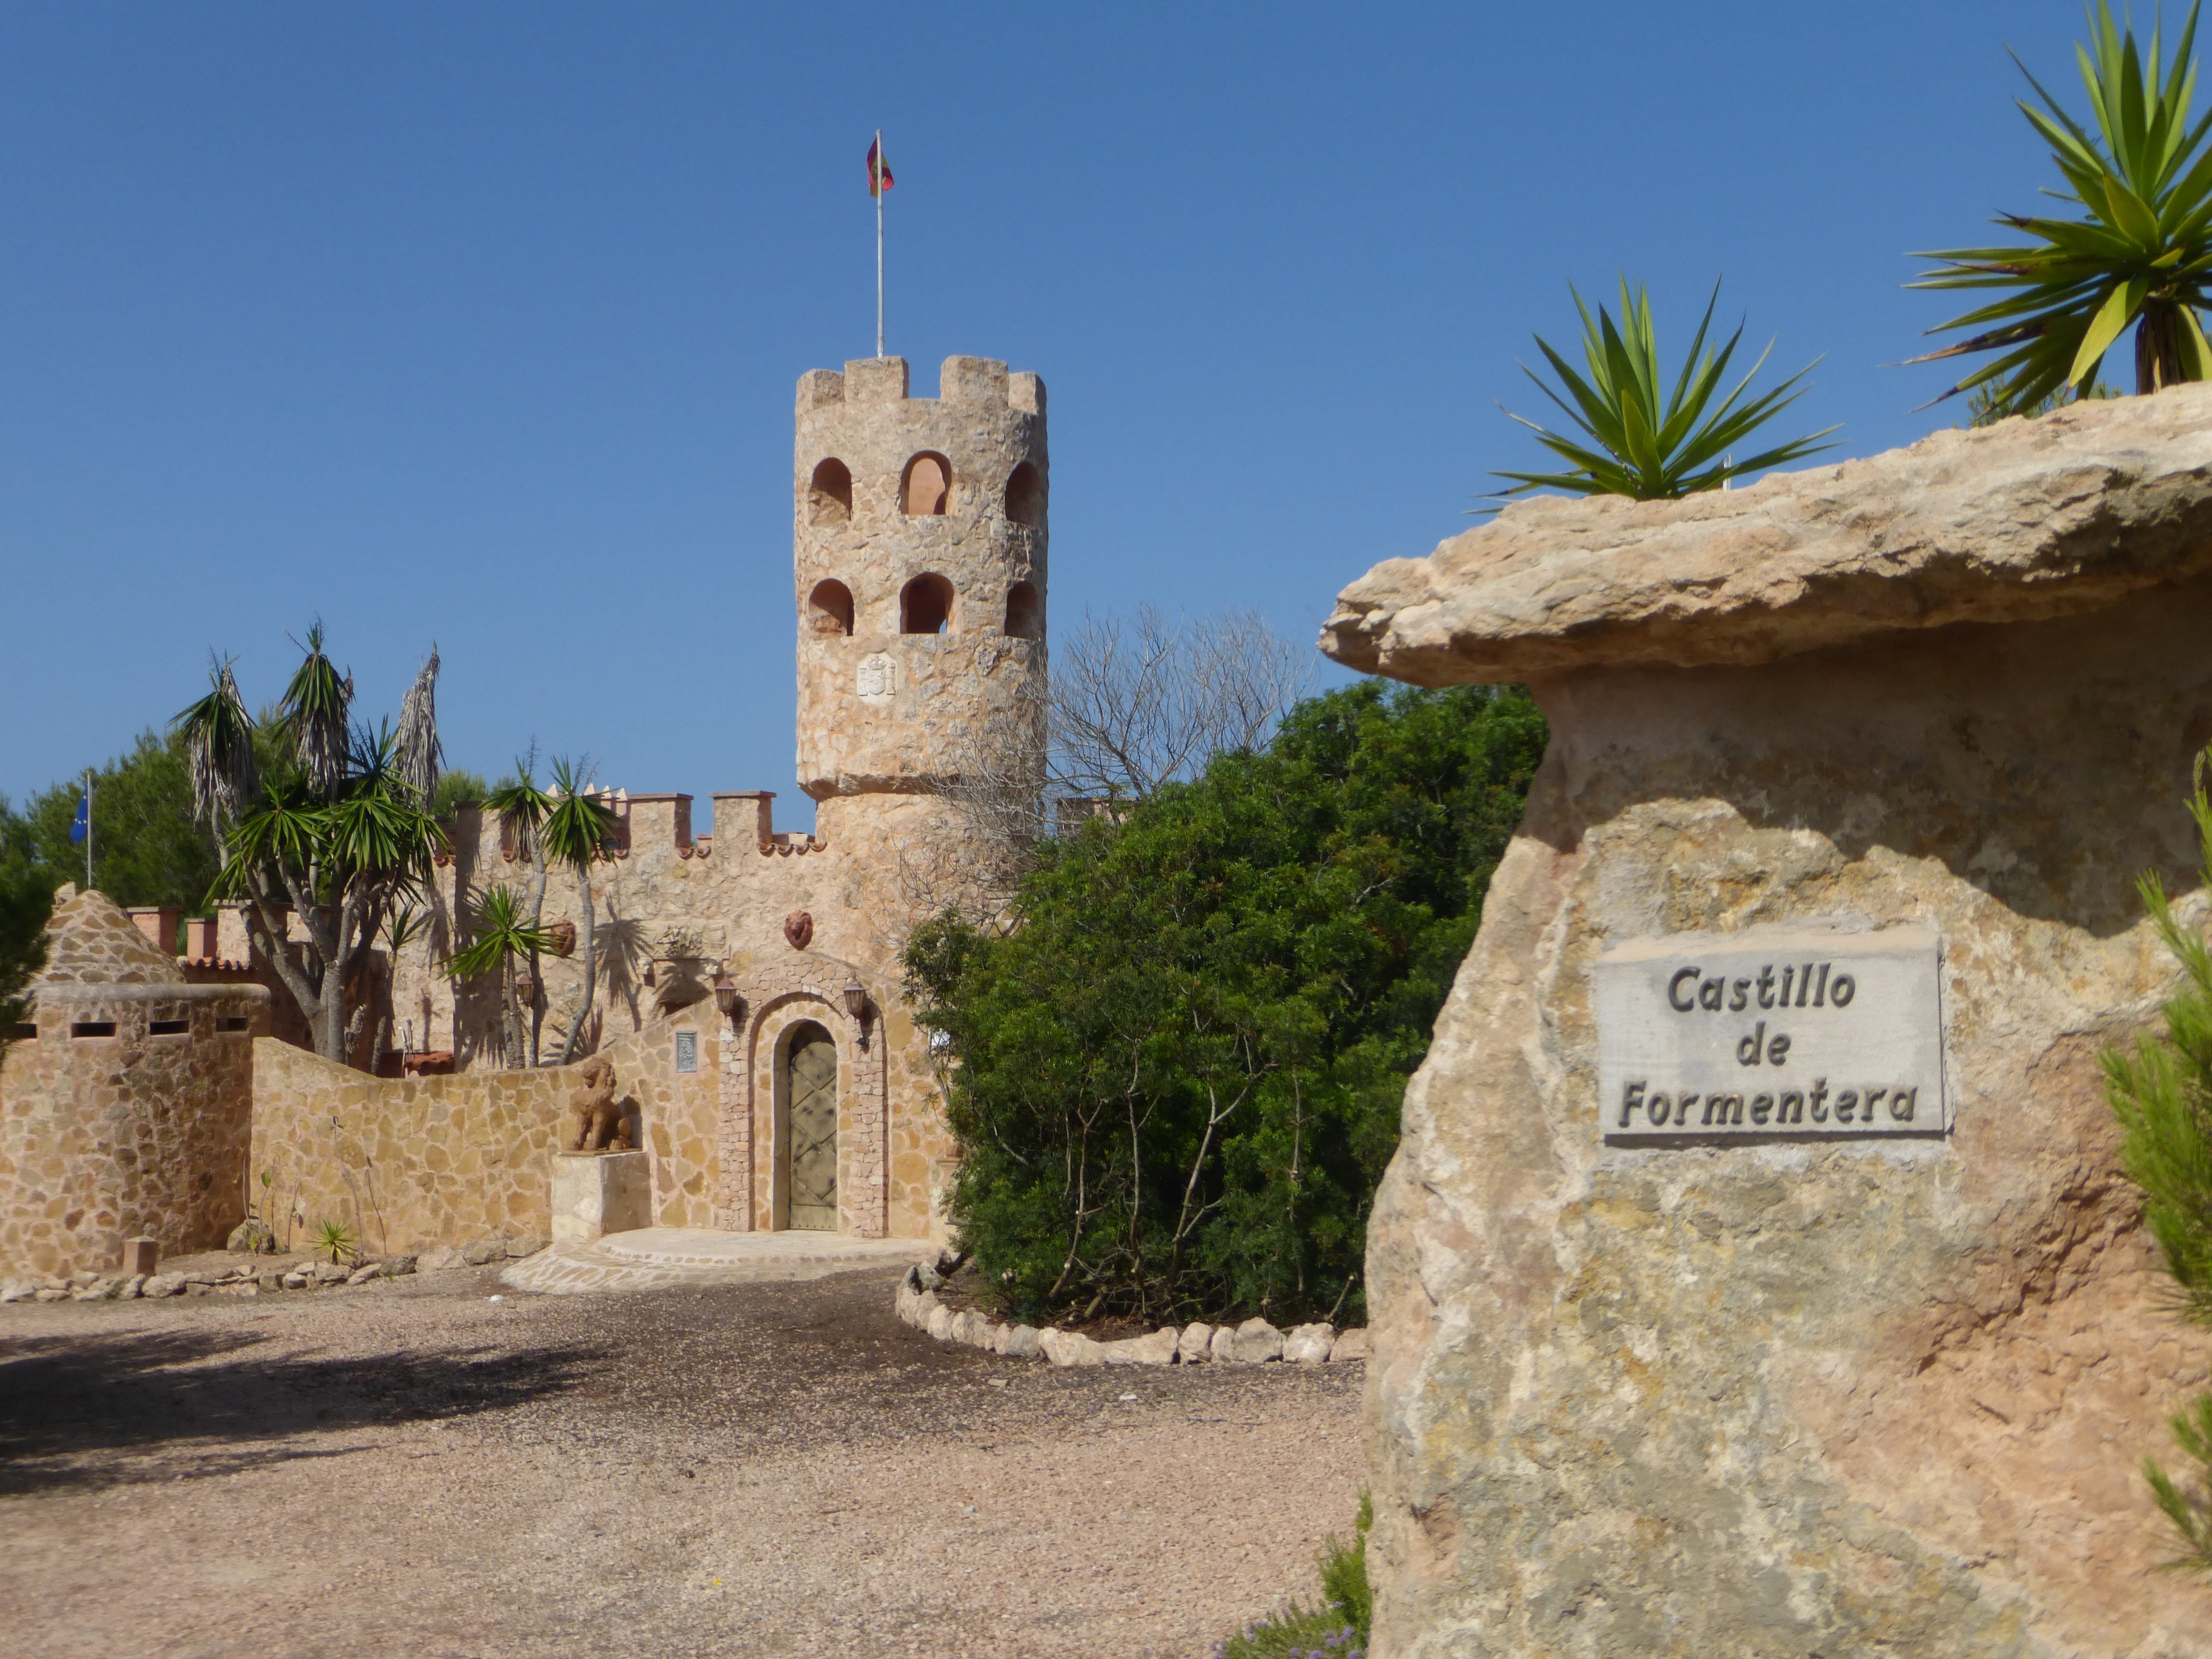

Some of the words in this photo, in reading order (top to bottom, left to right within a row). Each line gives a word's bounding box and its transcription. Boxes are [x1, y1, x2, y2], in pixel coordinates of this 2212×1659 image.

[1668, 962, 1855, 1012] Castillo
[1736, 1021, 1791, 1066] de
[1618, 1077, 1919, 1128] Formentera
